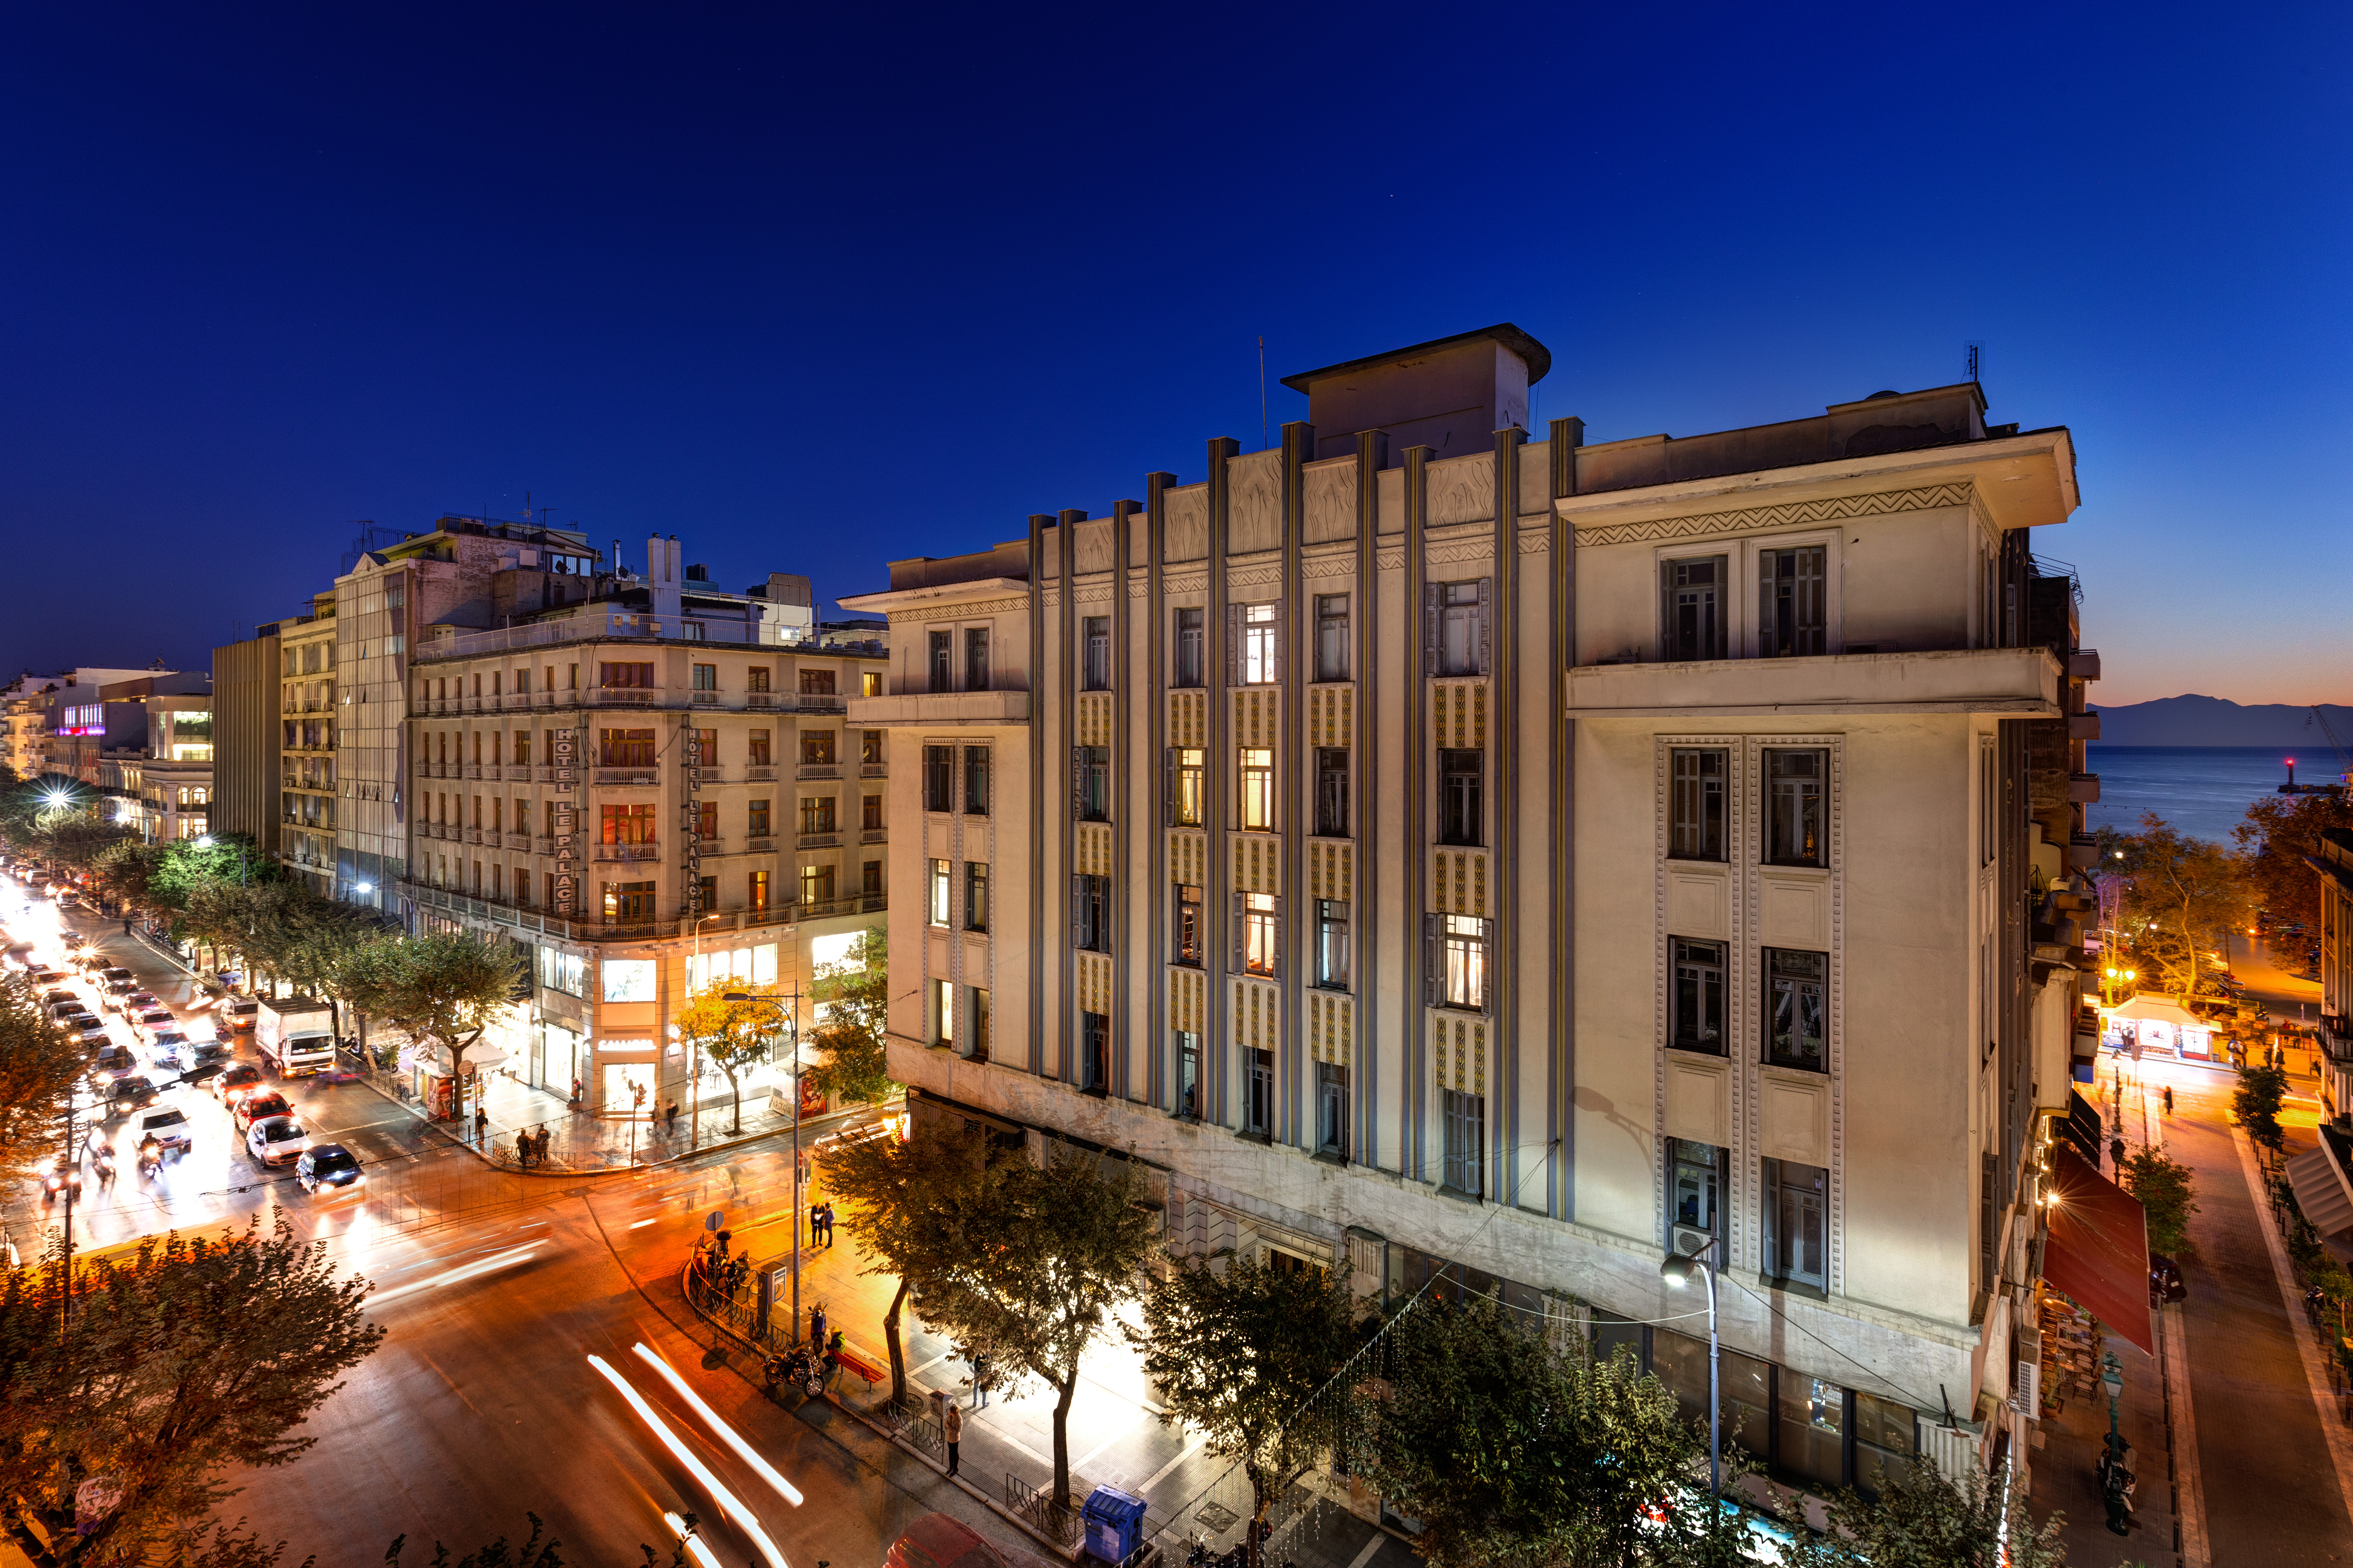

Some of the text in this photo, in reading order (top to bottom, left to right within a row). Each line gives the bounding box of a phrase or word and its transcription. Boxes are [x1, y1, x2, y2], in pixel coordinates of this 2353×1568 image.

[557, 730, 572, 912] HOTEL LE PALACE
[690, 801, 697, 824] LE
